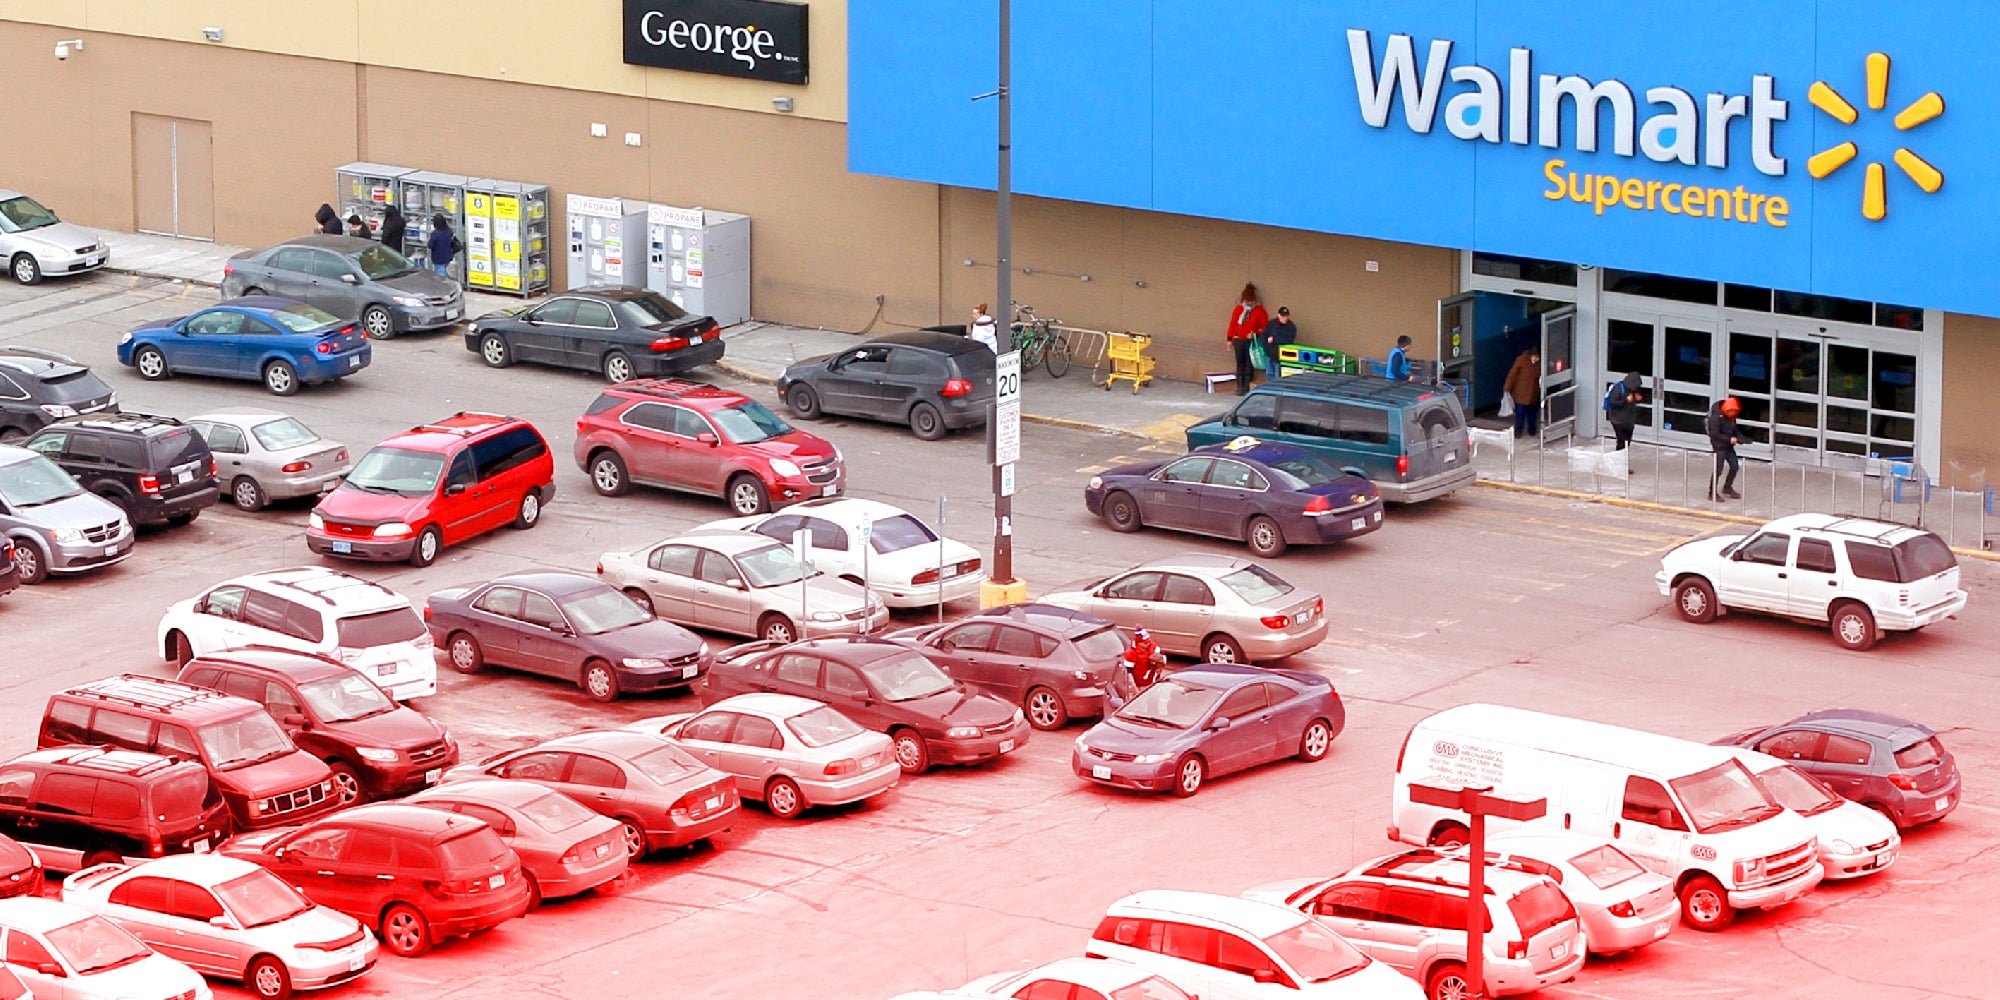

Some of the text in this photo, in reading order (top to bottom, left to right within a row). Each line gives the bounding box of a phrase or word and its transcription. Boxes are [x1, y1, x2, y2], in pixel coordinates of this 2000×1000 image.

[1346, 28, 1789, 176] Walmart
[1543, 159, 1789, 227] Supercentre
[583, 201, 620, 214] PROPANE
[664, 212, 701, 225] PROPANE
[999, 373, 1018, 398] 20
